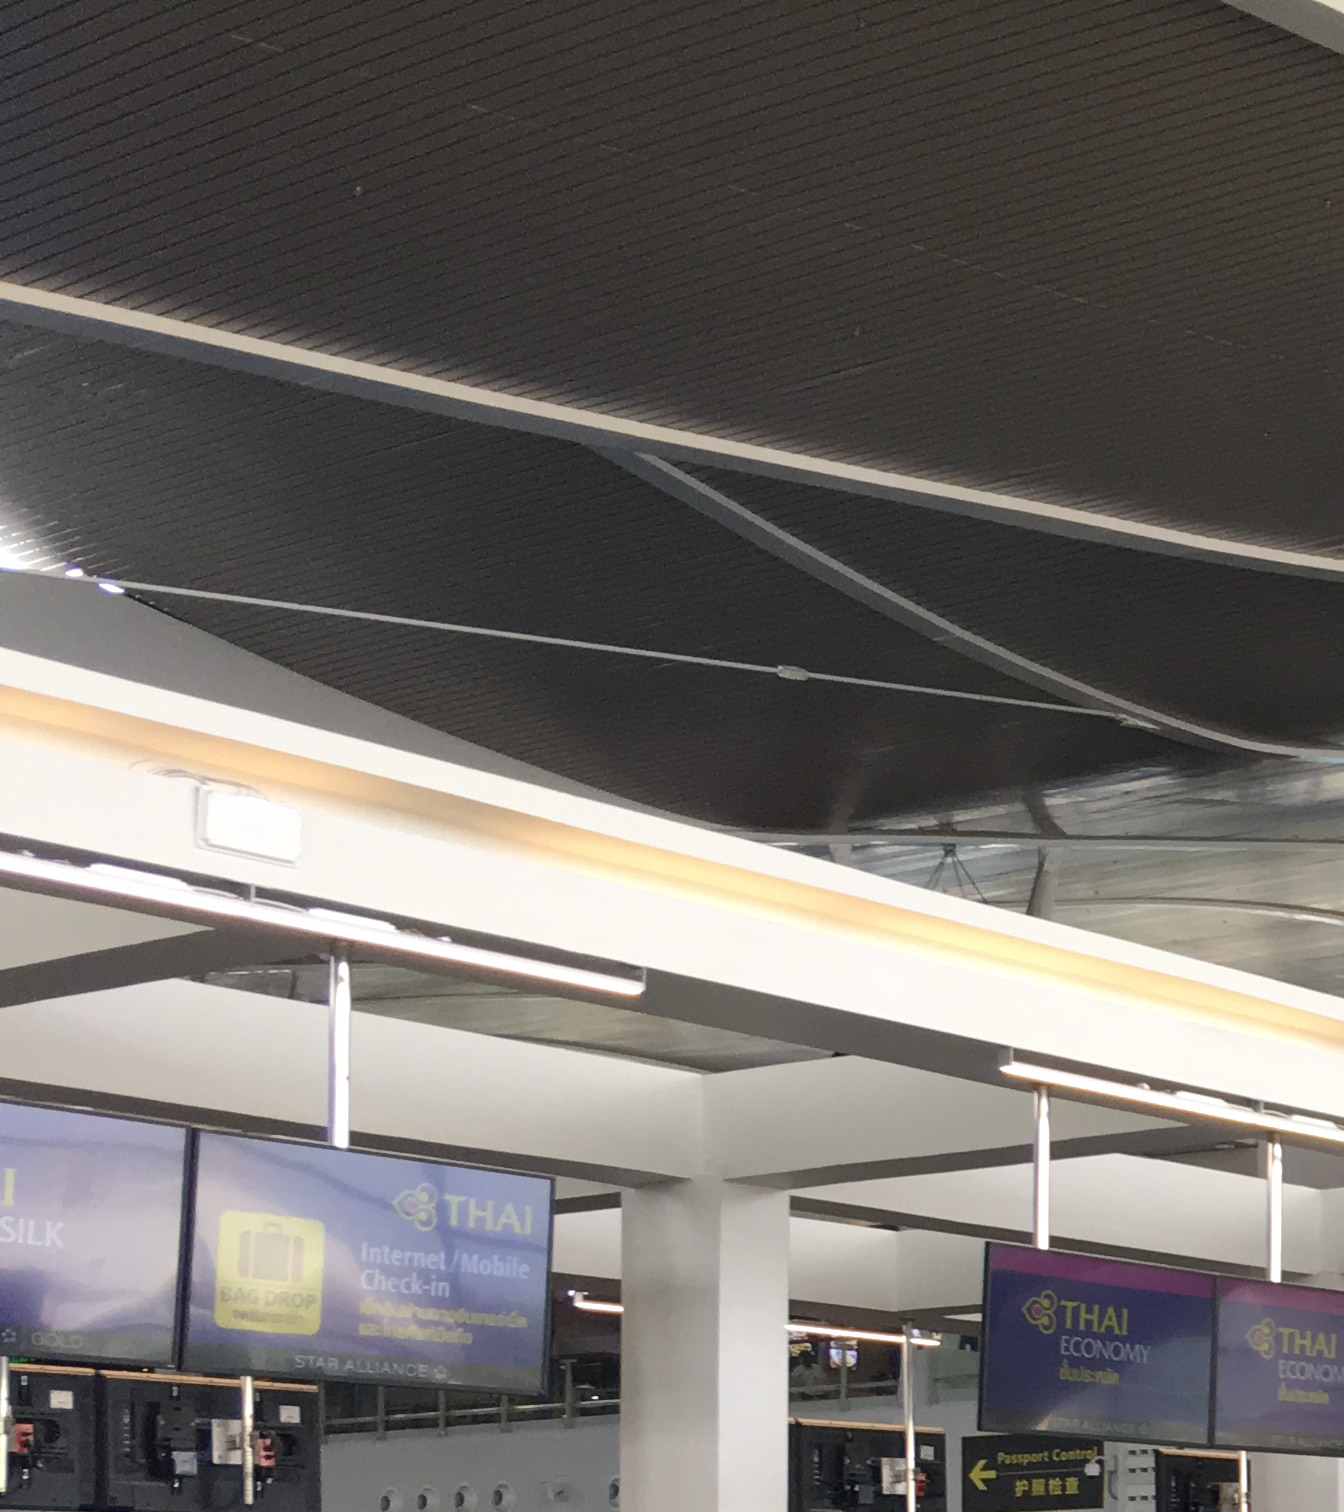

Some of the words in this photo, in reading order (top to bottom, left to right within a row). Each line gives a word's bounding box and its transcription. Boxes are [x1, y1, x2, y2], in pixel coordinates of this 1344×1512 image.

[445, 1193, 532, 1234] THAI
[0, 1216, 64, 1248] SILK
[220, 1286, 259, 1304] BAG
[265, 1289, 316, 1309] DROP
[360, 1270, 449, 1297] Check-in
[1060, 1300, 1128, 1335] THAI
[1061, 1336, 1152, 1364] ECONOMY
[1278, 1328, 1336, 1358] THAI
[295, 1354, 339, 1371] STAR
[344, 1359, 428, 1378] ALLIANCE
[998, 1448, 1049, 1465] Passport
[1053, 1446, 1098, 1461] Control
